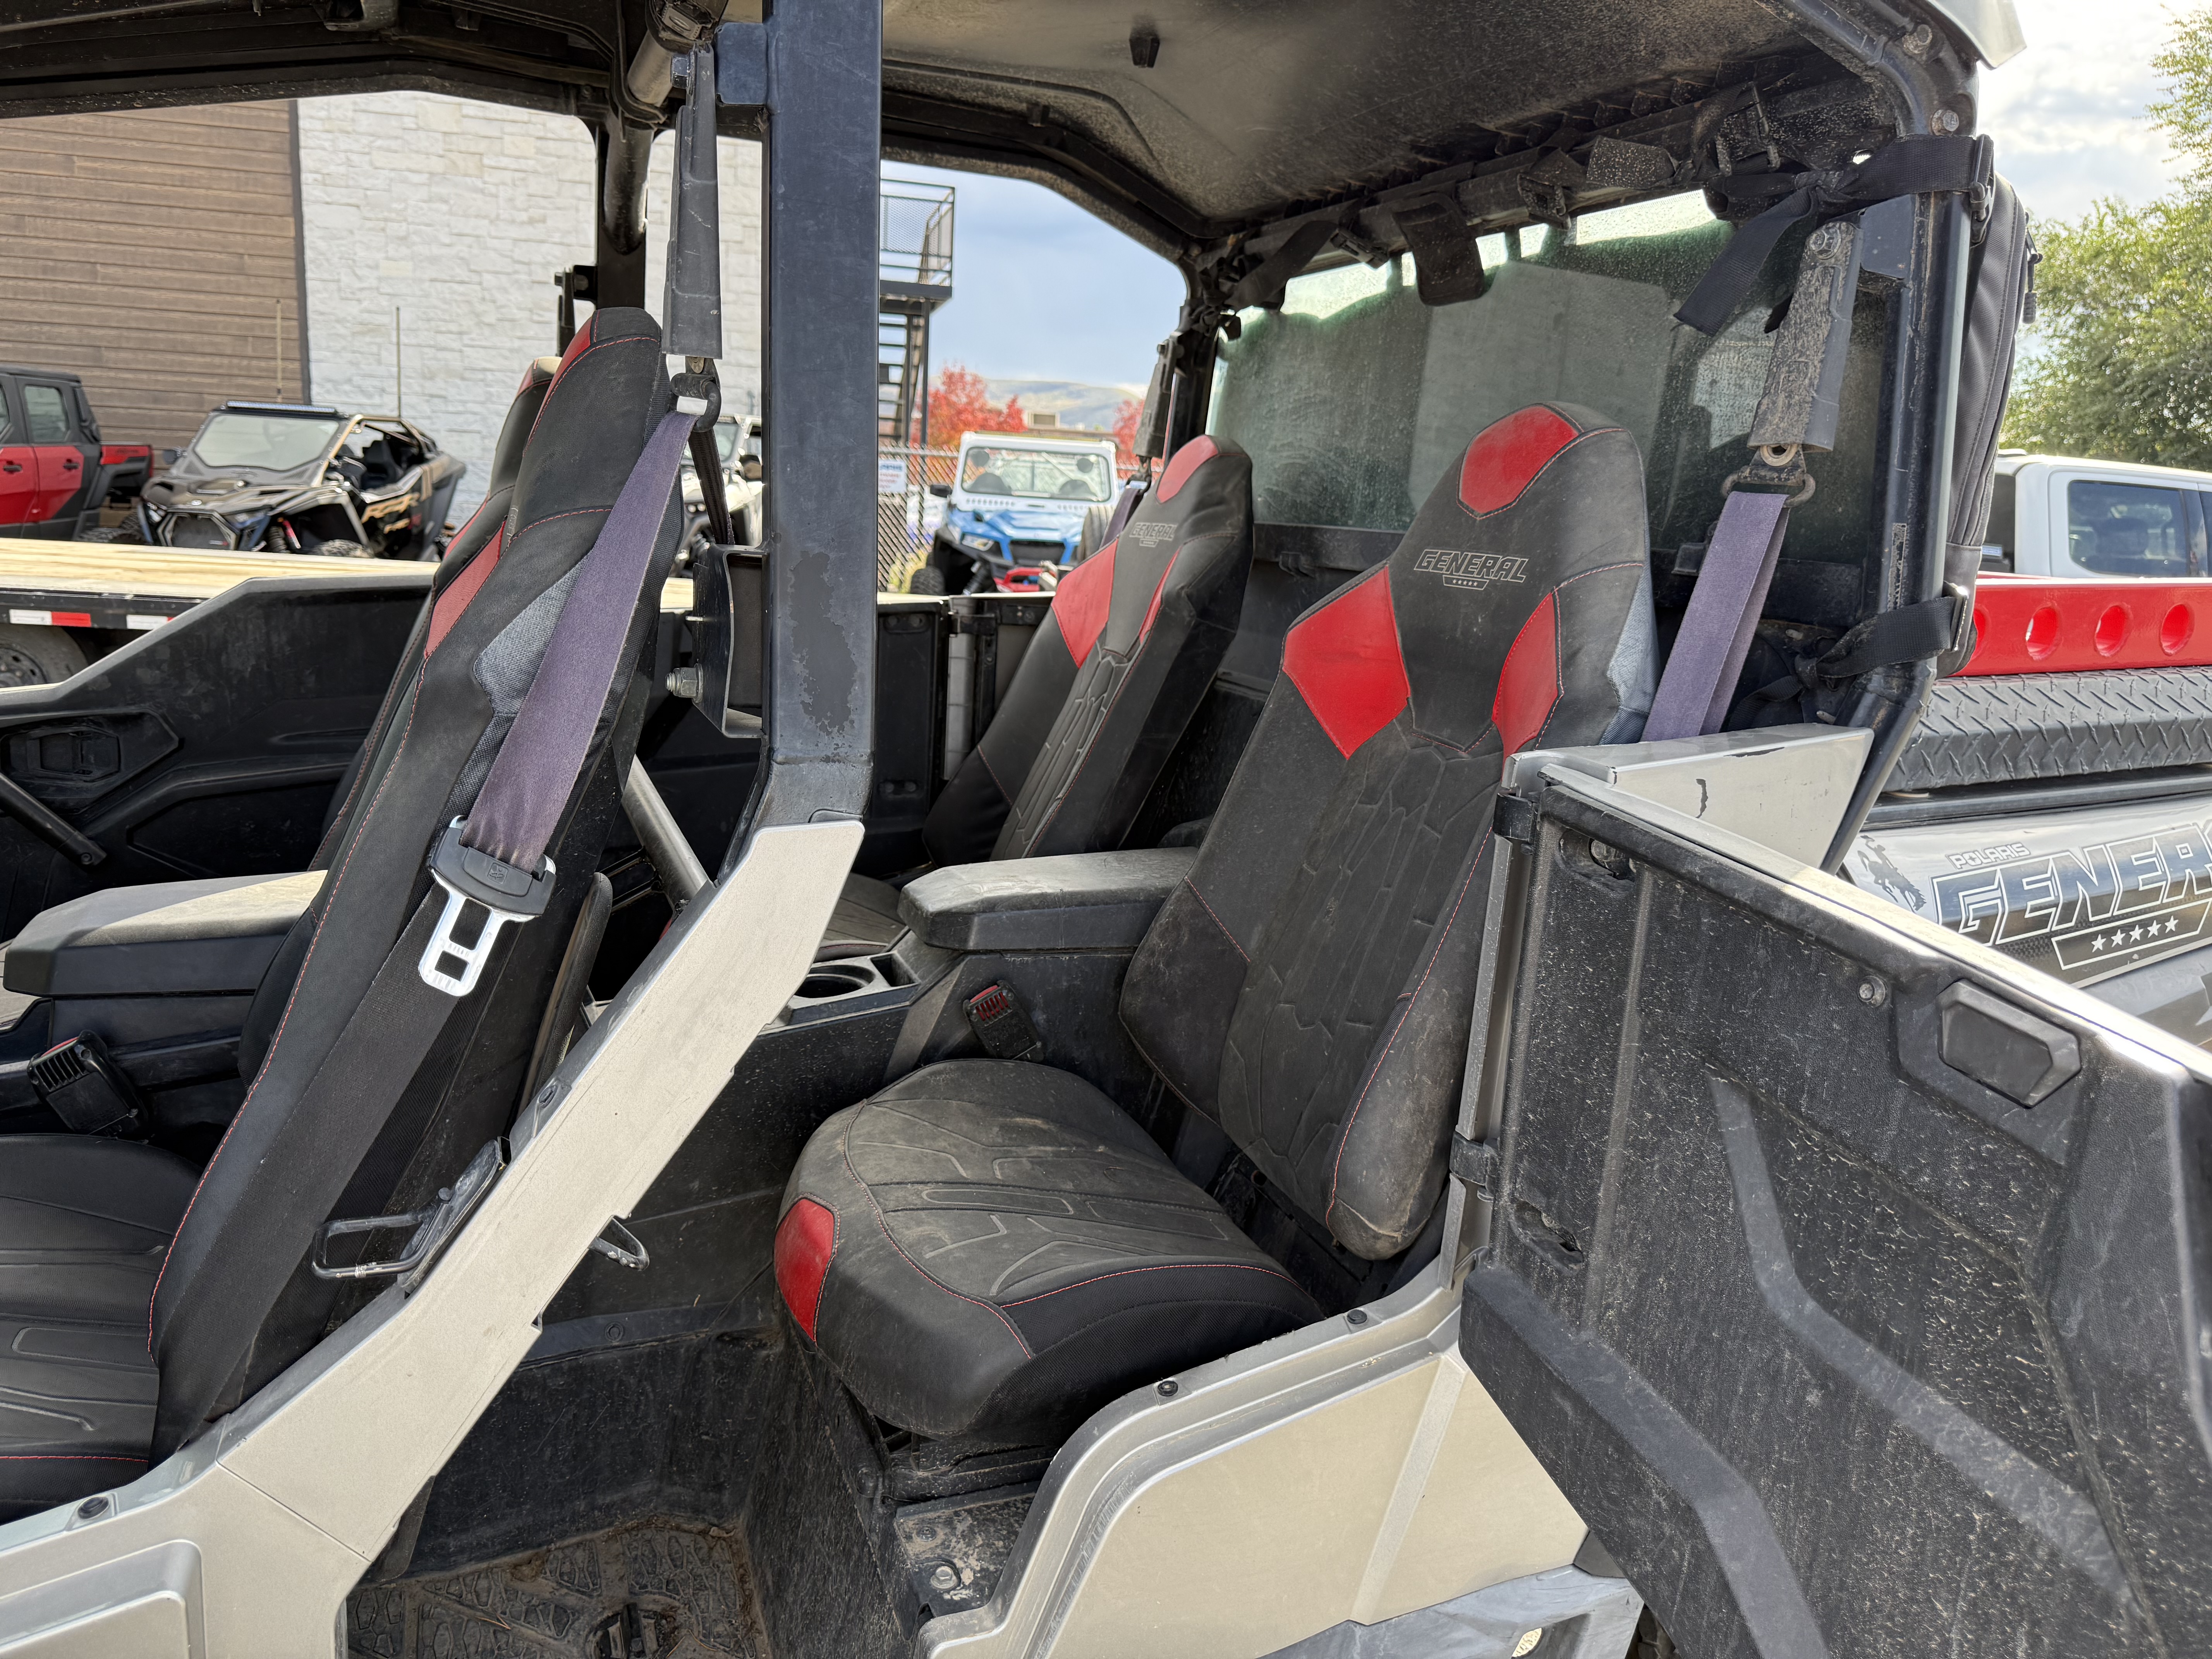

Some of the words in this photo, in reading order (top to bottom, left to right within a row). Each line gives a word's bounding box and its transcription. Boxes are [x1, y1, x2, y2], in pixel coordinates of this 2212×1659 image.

[1129, 522, 1178, 541] GENERAL
[1413, 549, 1530, 583] GENERAL
[1948, 842, 2031, 869] POLARIS
[1931, 821, 2212, 946] GENER
